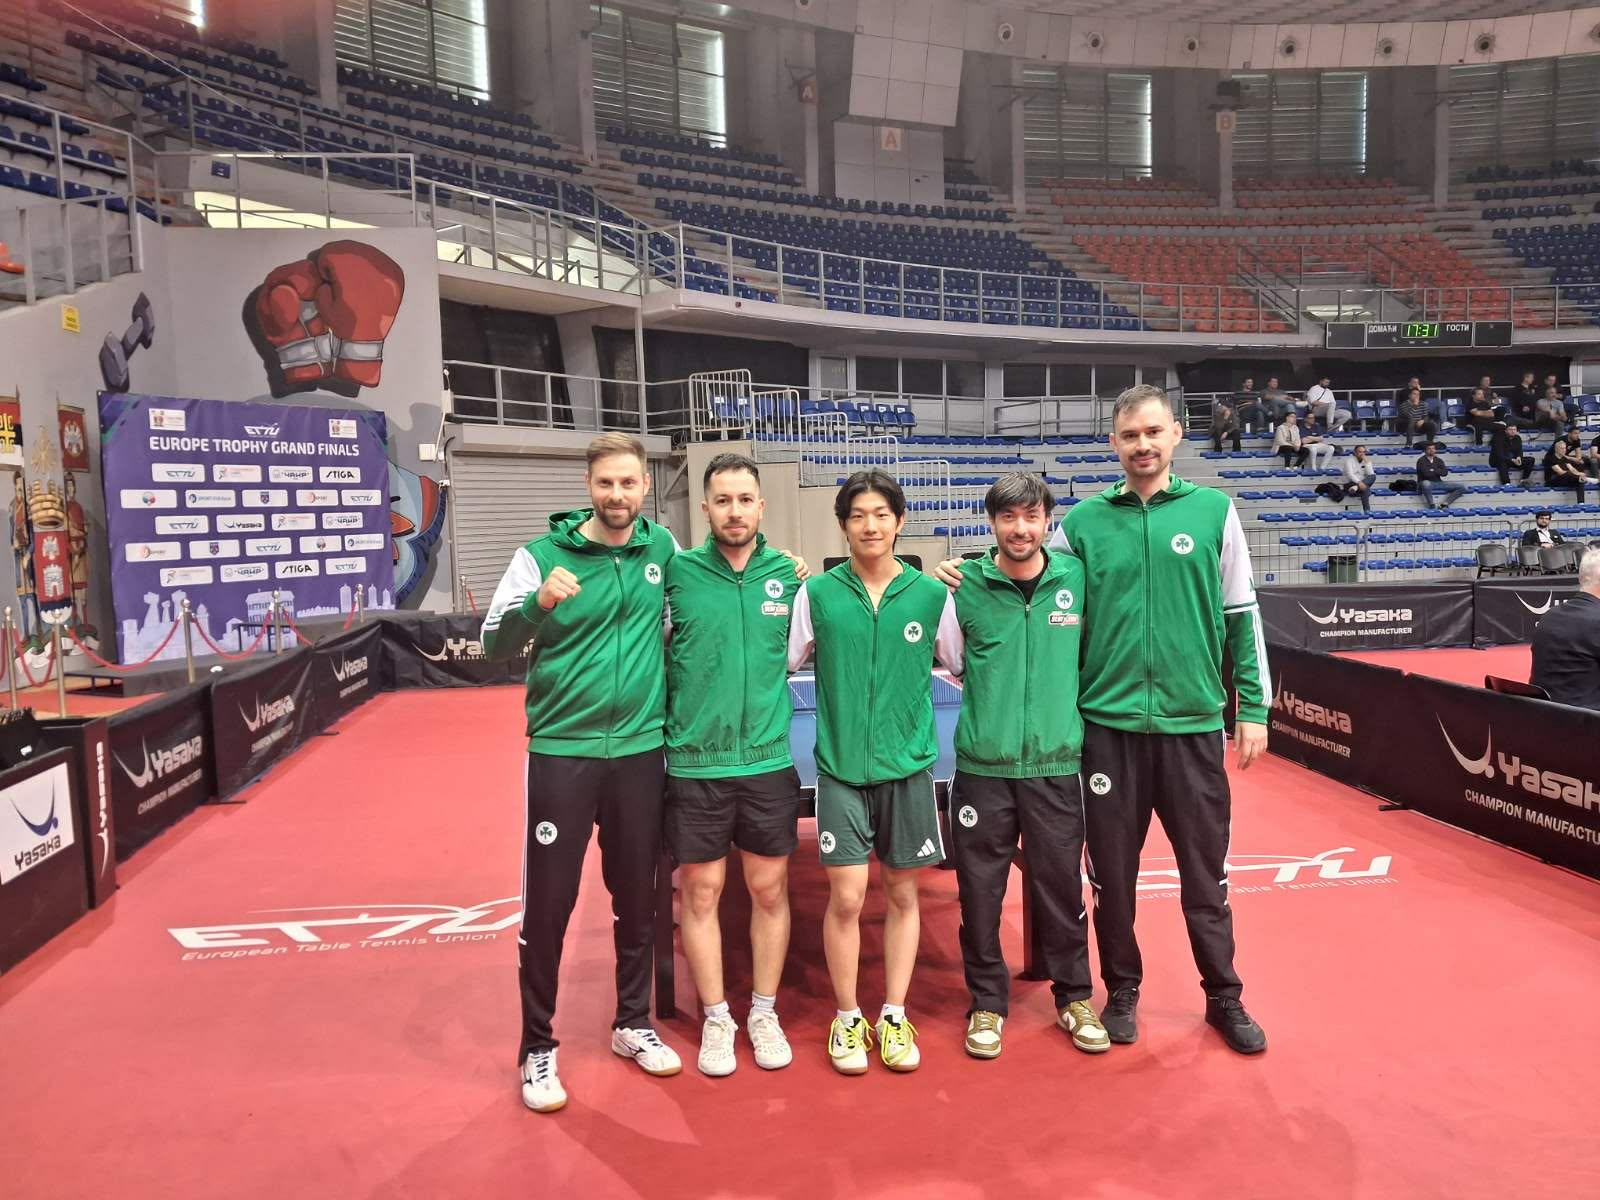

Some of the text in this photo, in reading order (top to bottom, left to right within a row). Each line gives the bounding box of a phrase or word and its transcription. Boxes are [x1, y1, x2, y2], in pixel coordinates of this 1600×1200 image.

[884, 129, 897, 149] A
[1368, 323, 1397, 333] ДОМАЋИ
[1407, 324, 1438, 336] 17:31
[1446, 323, 1470, 332] ГОСТИ
[149, 436, 360, 456] EUROPE TROPHY GRAND FINALS
[326, 470, 354, 478] STIGA
[282, 564, 313, 574] STIGA
[1340, 608, 1412, 623] Yasaka
[1320, 627, 1412, 638] CHAMPION MANUFACTURER
[1283, 691, 1352, 734] Yasaka
[1299, 731, 1351, 758] MANUFACTURER
[150, 735, 202, 778] Yasaka
[1498, 752, 1600, 814] Yasak
[1464, 789, 1600, 846] CHAMPION MANUFACTU
[15, 834, 61, 871] Yasaka
[1273, 880, 1340, 890] Tennis
[1342, 876, 1398, 887] Union
[181, 933, 497, 961] European Table Tennis Union
